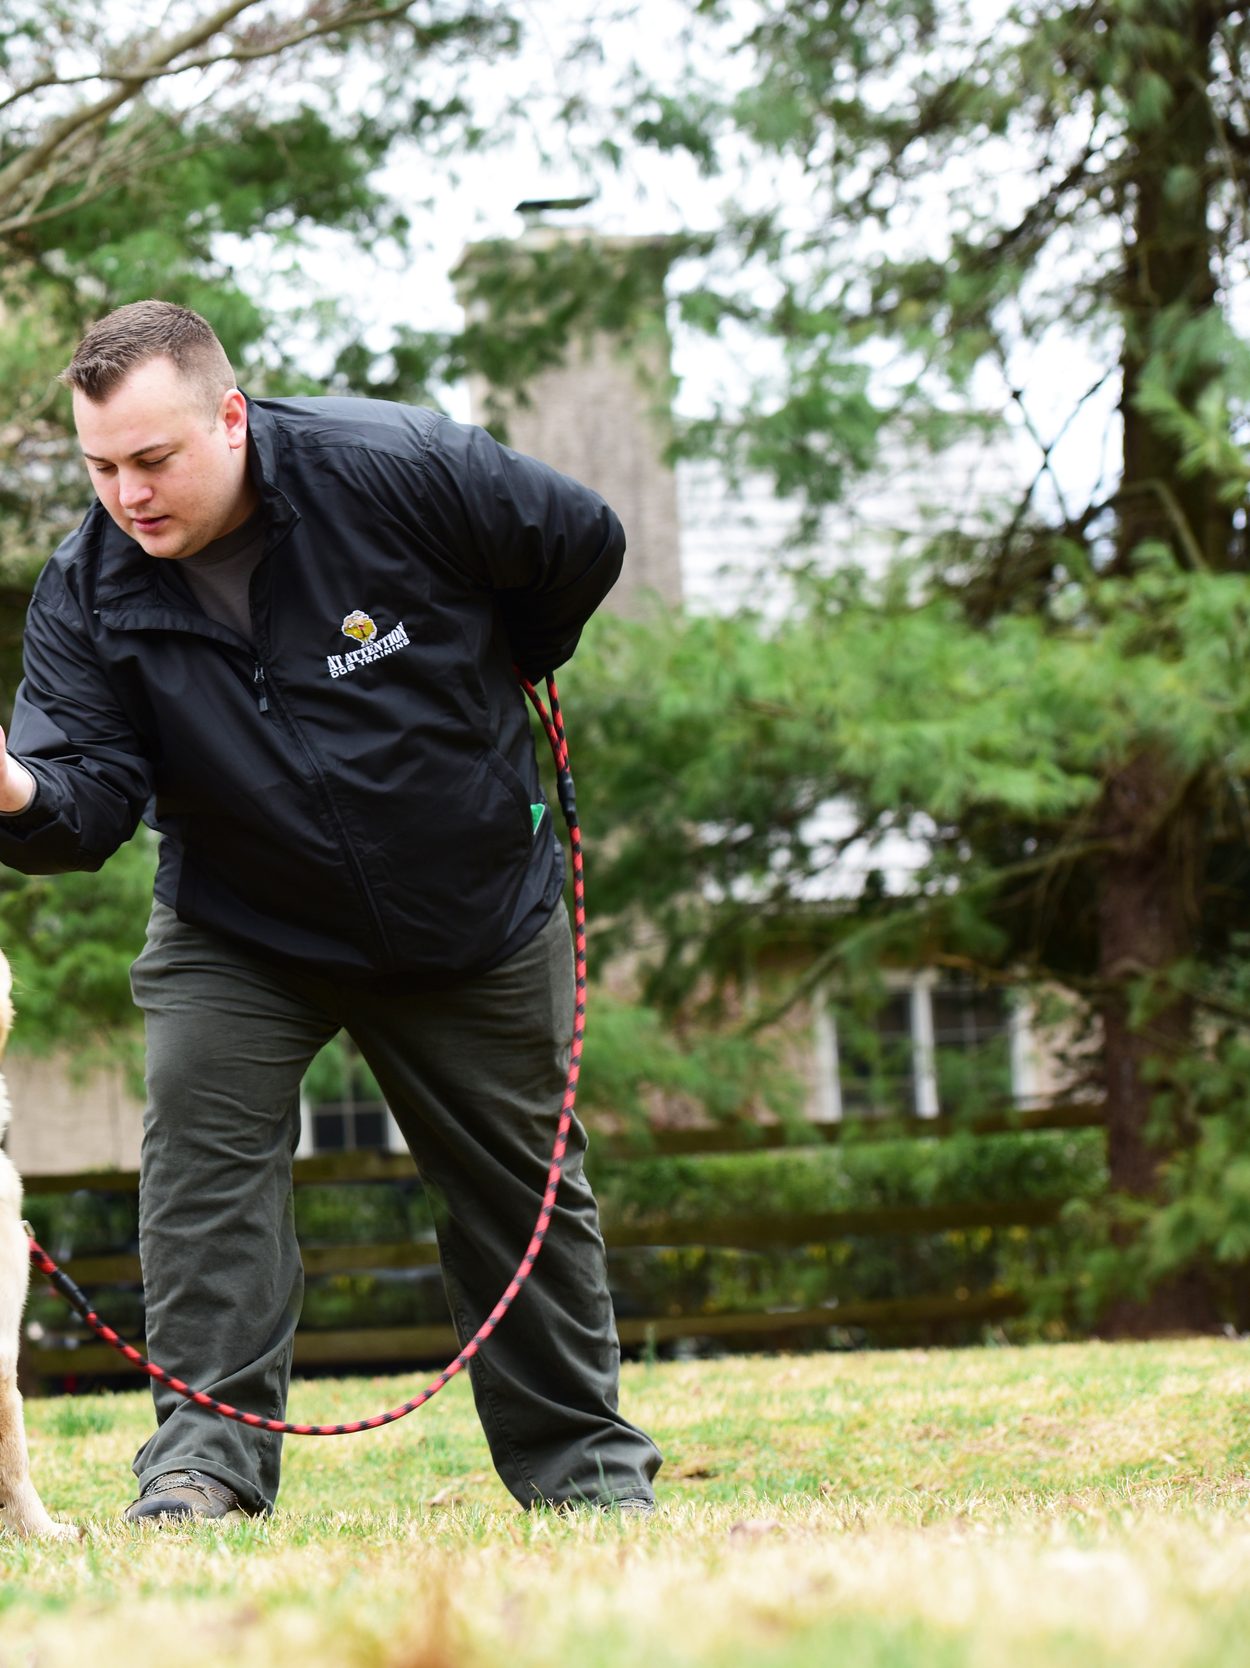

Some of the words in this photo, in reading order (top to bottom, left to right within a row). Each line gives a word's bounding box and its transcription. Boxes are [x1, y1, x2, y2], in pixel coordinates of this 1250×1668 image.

[327, 654, 344, 672] AT
[344, 621, 408, 665] ATTENTION
[330, 663, 356, 678] DOG
[358, 638, 410, 666] TRAINING
